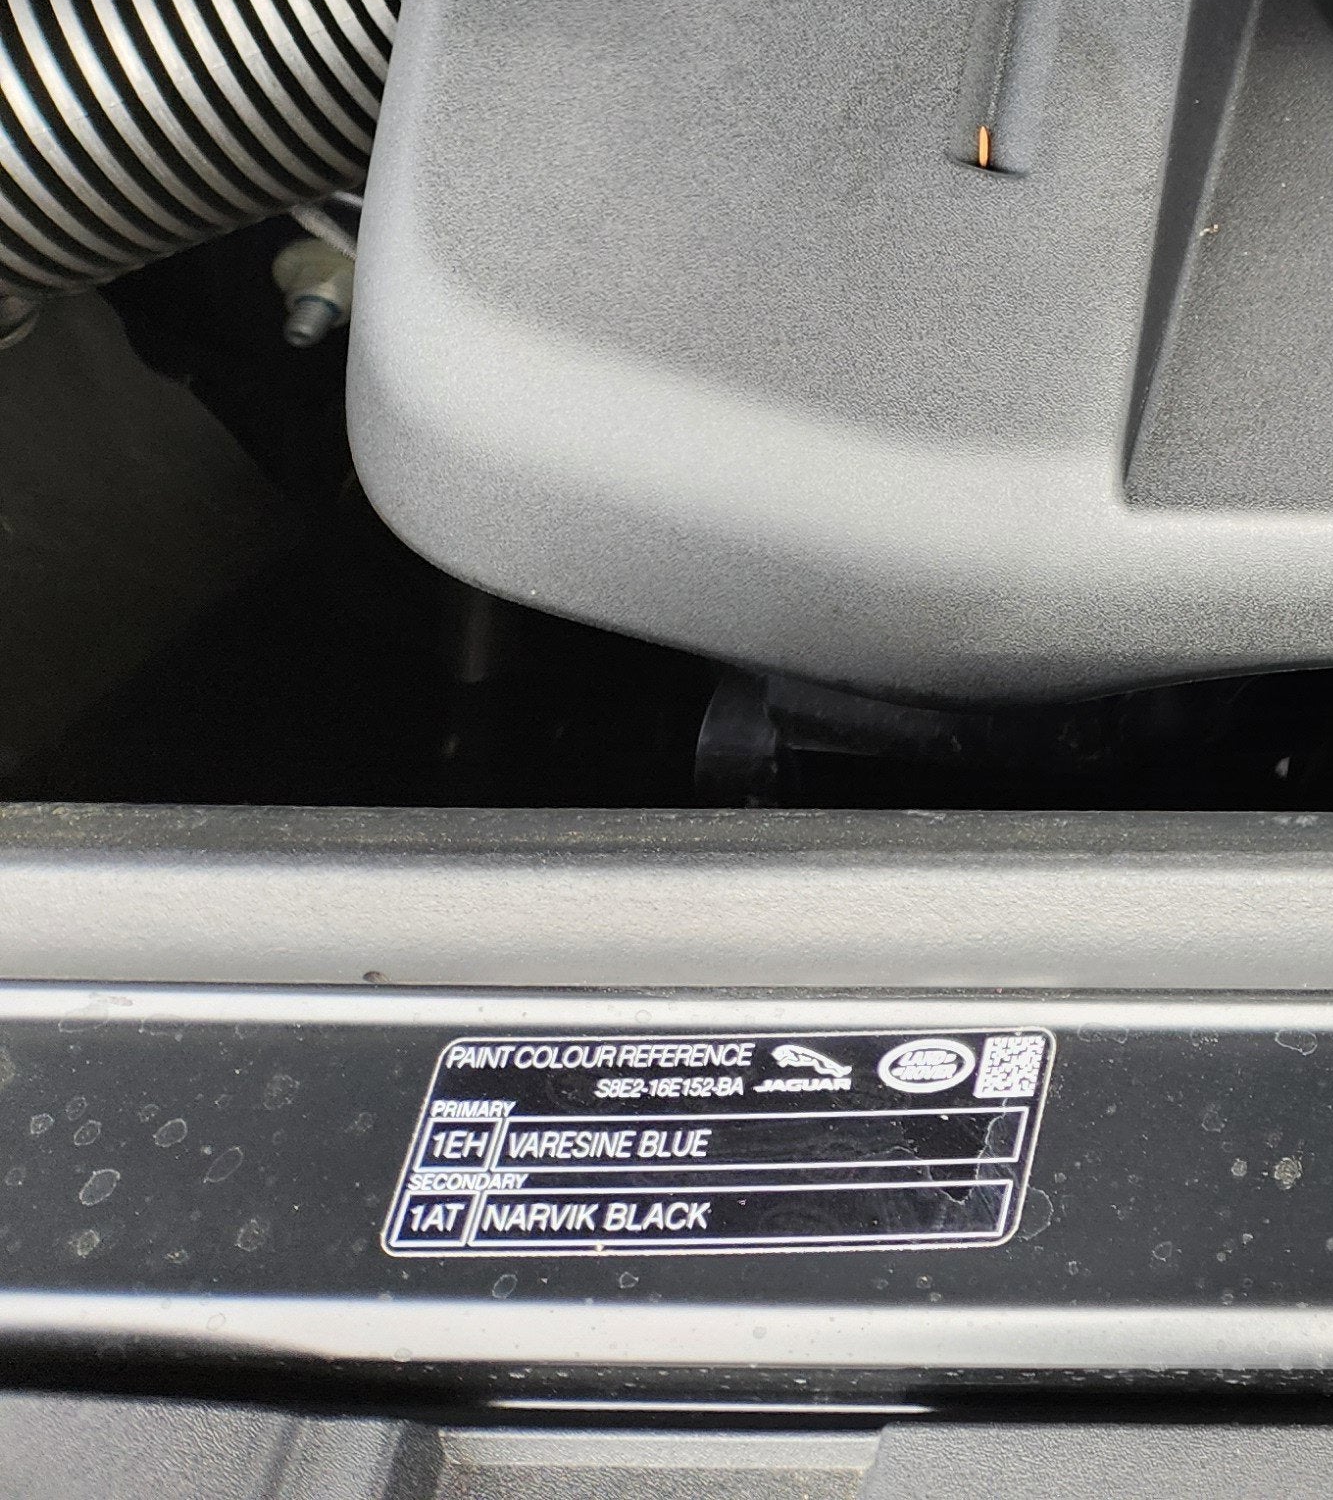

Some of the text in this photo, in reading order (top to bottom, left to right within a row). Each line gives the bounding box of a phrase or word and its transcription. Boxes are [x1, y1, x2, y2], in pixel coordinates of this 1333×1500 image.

[446, 1043, 755, 1069] PAINT COLOUR REFERENCE
[594, 1077, 744, 1098] S8E2-16E152-BA
[752, 1078, 852, 1093] JAGUAR
[430, 1100, 517, 1118] PRIMARY
[431, 1129, 713, 1159] 1EH VARESINE BLUE
[407, 1173, 529, 1191] SECONDARY
[409, 1201, 711, 1232] 1AT NARVIK BLACK
